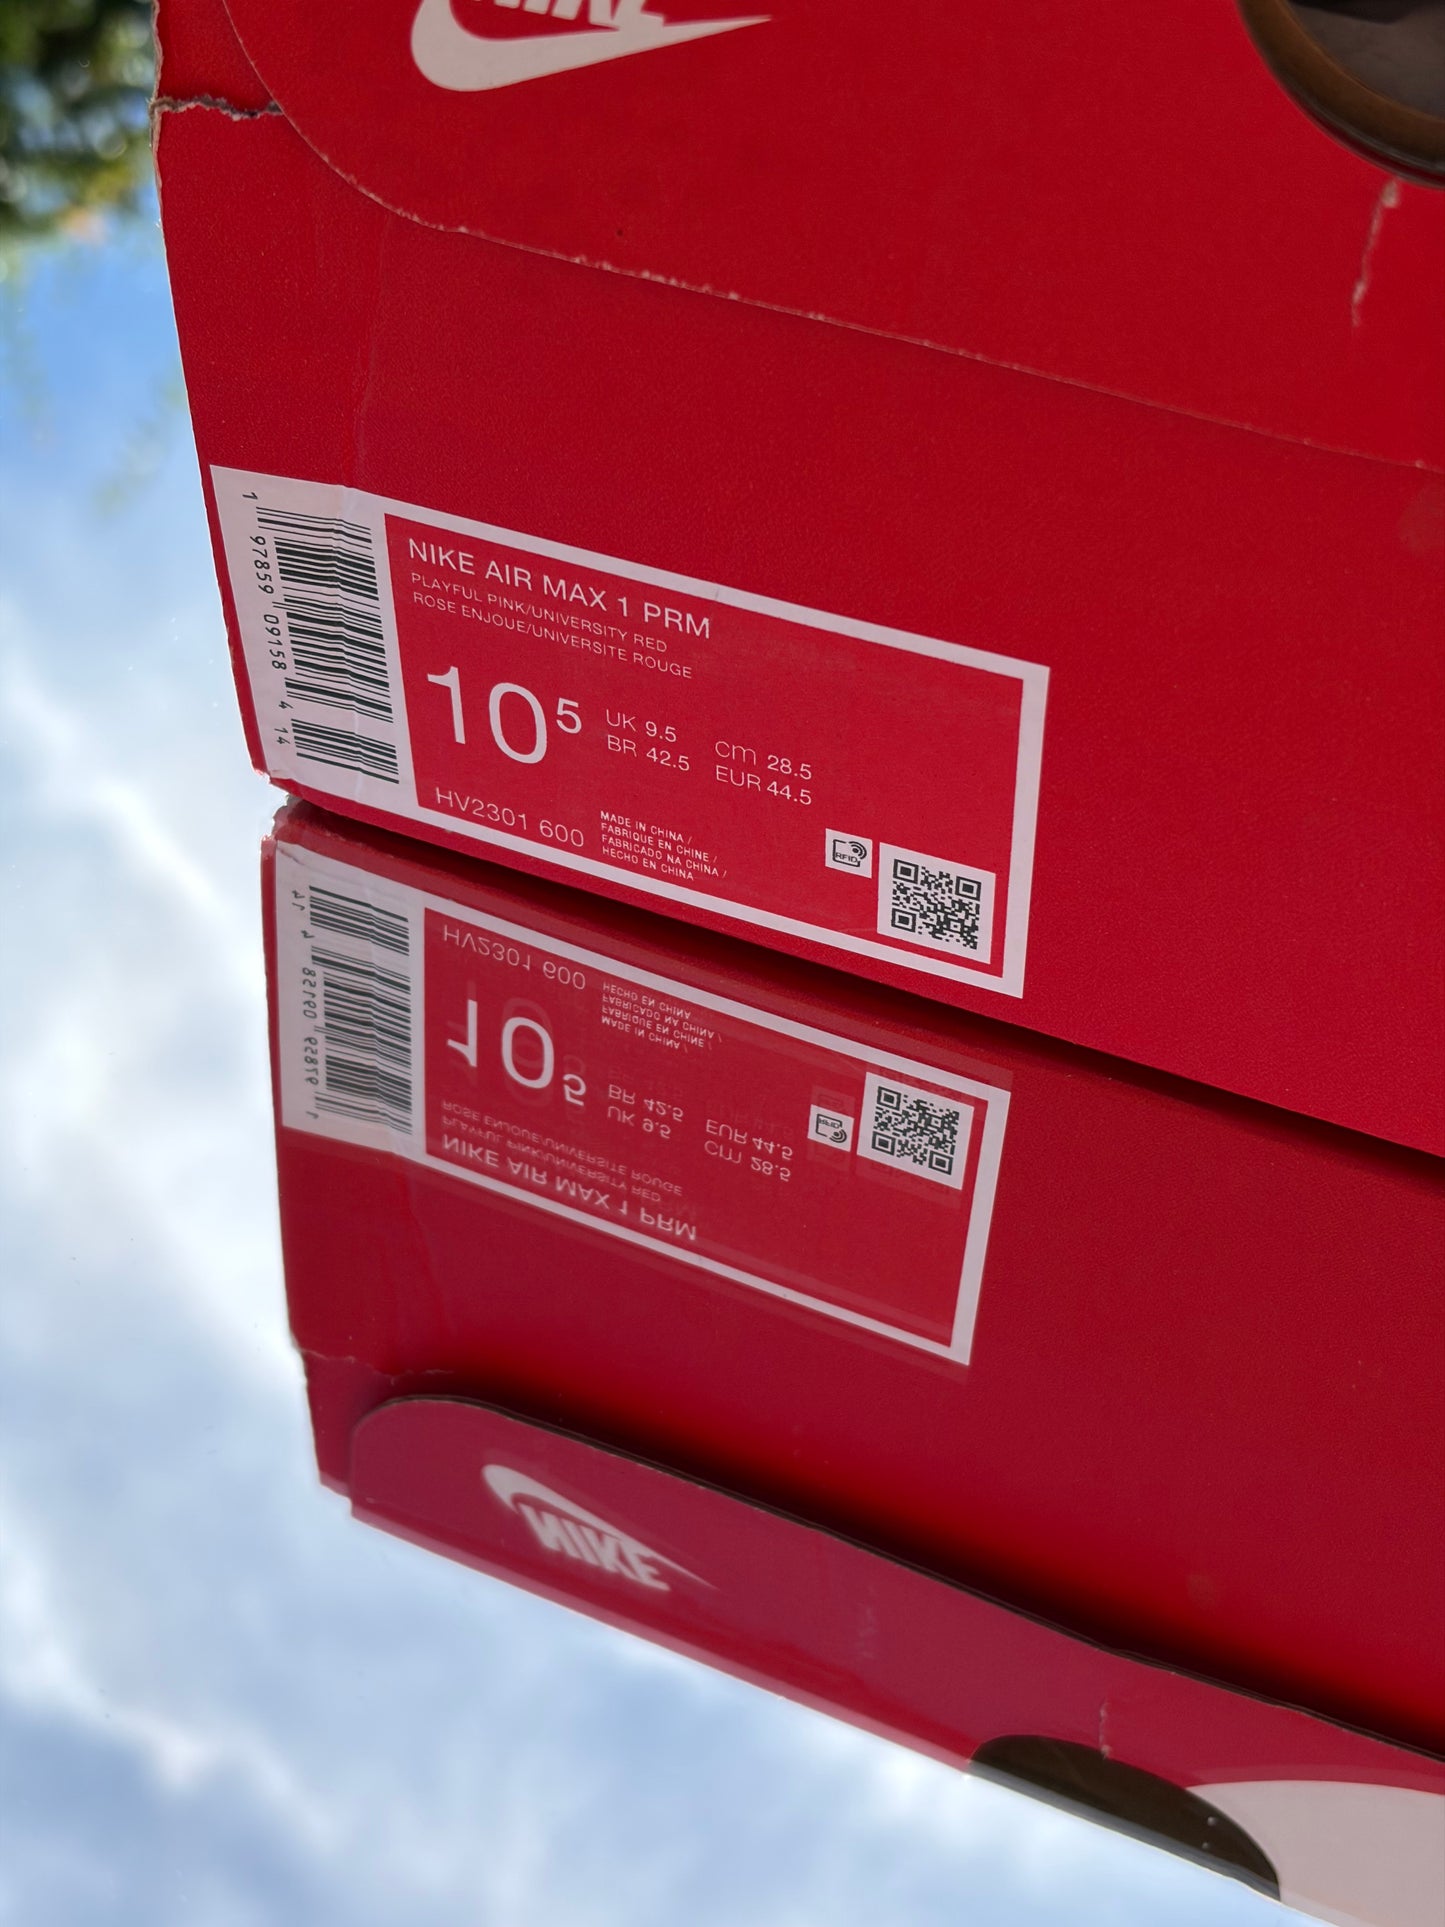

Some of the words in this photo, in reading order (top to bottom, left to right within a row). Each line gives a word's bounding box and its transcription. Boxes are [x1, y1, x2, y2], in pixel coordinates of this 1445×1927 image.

[242, 491, 258, 500] 1
[250, 535, 274, 595] 97859
[409, 538, 475, 575] NIKE
[485, 560, 532, 591] AIR
[543, 574, 607, 611] MAX
[617, 597, 628, 617] 1
[643, 602, 710, 639] PRM
[411, 572, 482, 602] PLAYFUL
[487, 593, 628, 641] PINK/UNIVERSITY
[633, 633, 667, 653] RED
[264, 614, 287, 671] 09158
[413, 592, 456, 614] ROSE
[462, 605, 628, 661] ENJOUE/UNIVERSITE
[633, 652, 692, 679] ROUGE
[278, 700, 294, 709] 4
[274, 727, 291, 745] 14
[606, 709, 636, 732] UK
[645, 721, 677, 743] 9.5
[607, 734, 637, 757] BR
[646, 747, 690, 771] 42.5
[767, 755, 812, 780] 28.5
[716, 765, 761, 791] EUR
[767, 781, 812, 805] 44.5
[436, 787, 527, 830] HV2301
[540, 820, 584, 847] 600
[600, 810, 631, 828] MADE
[635, 821, 646, 832] IN
[650, 826, 684, 843] CHINA
[601, 823, 654, 846] FABRIQUE
[658, 839, 671, 851] EN
[676, 845, 709, 862] CHINE
[602, 834, 662, 860] FABRICADO
[667, 854, 682, 866] NA
[685, 860, 719, 877] CHINA
[835, 852, 858, 863] RFID
[602, 847, 638, 864] HECHO
[642, 858, 656, 870] EN
[661, 863, 694, 880] CHINA
